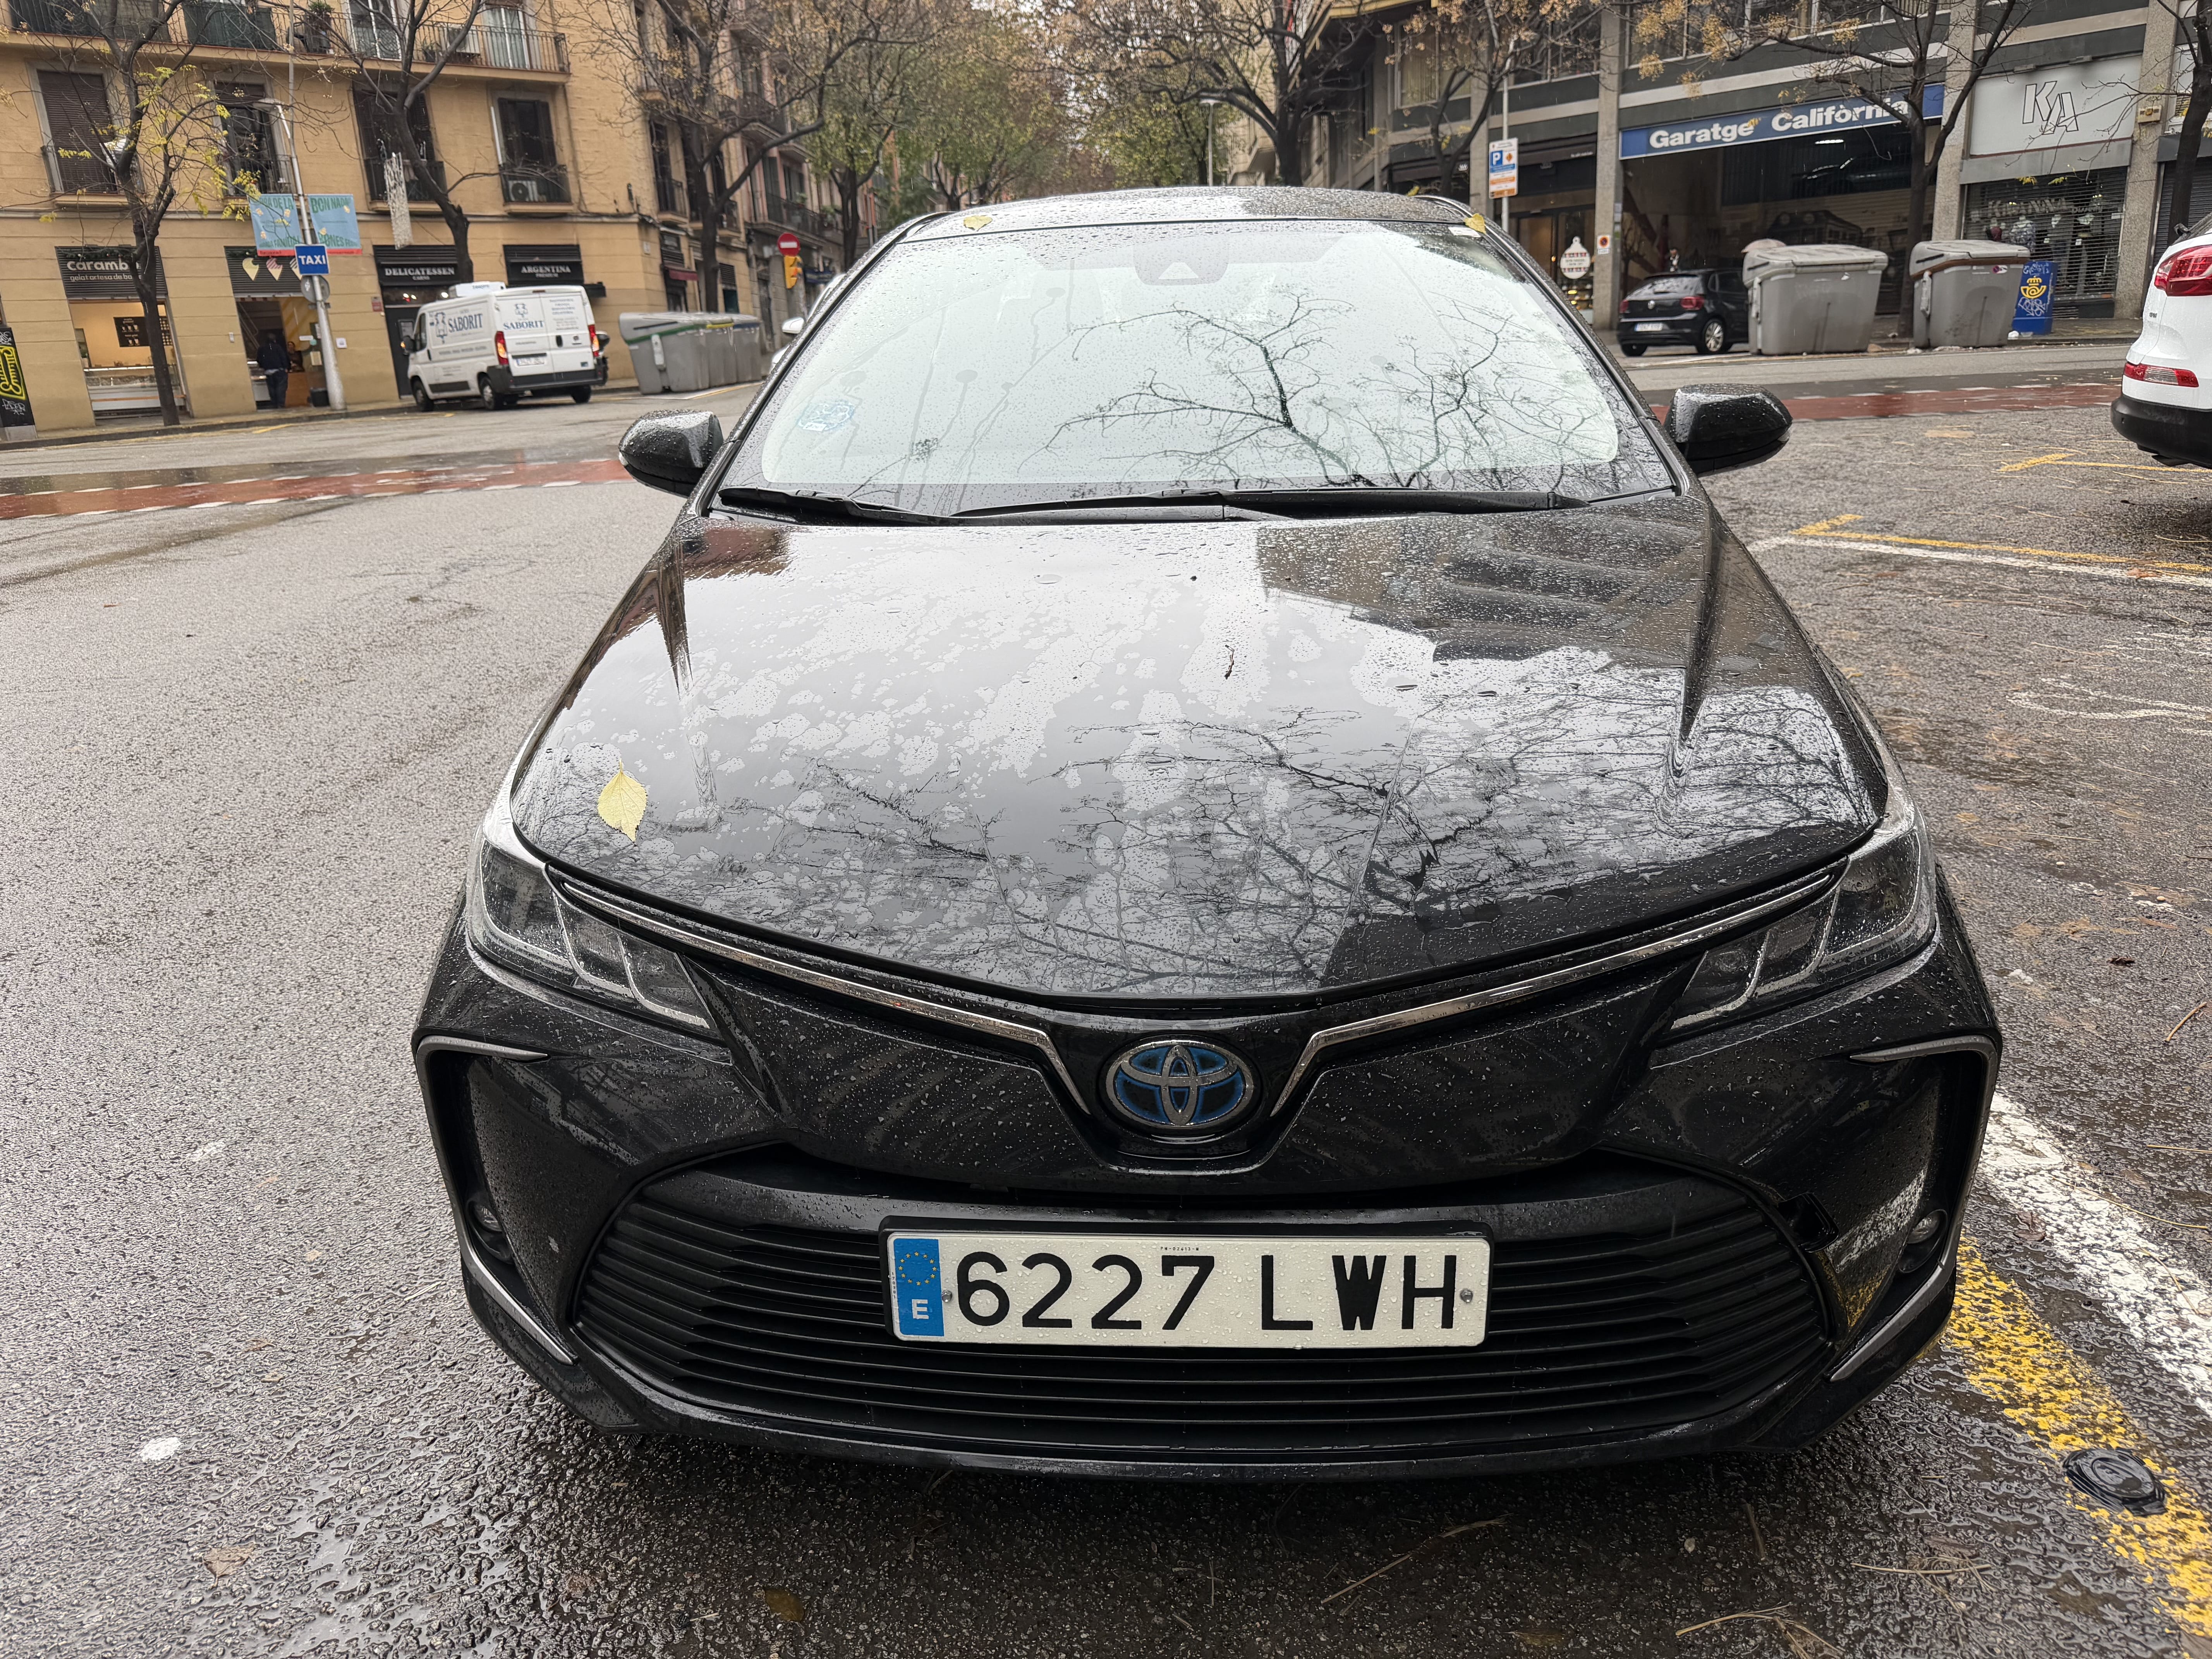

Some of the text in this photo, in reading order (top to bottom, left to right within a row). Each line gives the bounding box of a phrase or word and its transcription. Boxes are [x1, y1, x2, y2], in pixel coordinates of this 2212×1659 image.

[2022, 81, 2079, 135] KA
[1649, 98, 1908, 148] Garatge Califòrnia
[1492, 153, 1501, 165] P
[310, 198, 330, 213] BCN
[67, 257, 142, 271] caramb
[298, 255, 326, 265] TAXI
[70, 274, 88, 282] gelat
[385, 267, 455, 276] DELICATESSEN
[448, 313, 483, 333] SABORIT
[503, 320, 544, 330] SABORIT
[957, 1252, 1456, 1330] 6227 LWH
[912, 1299, 929, 1319] E
